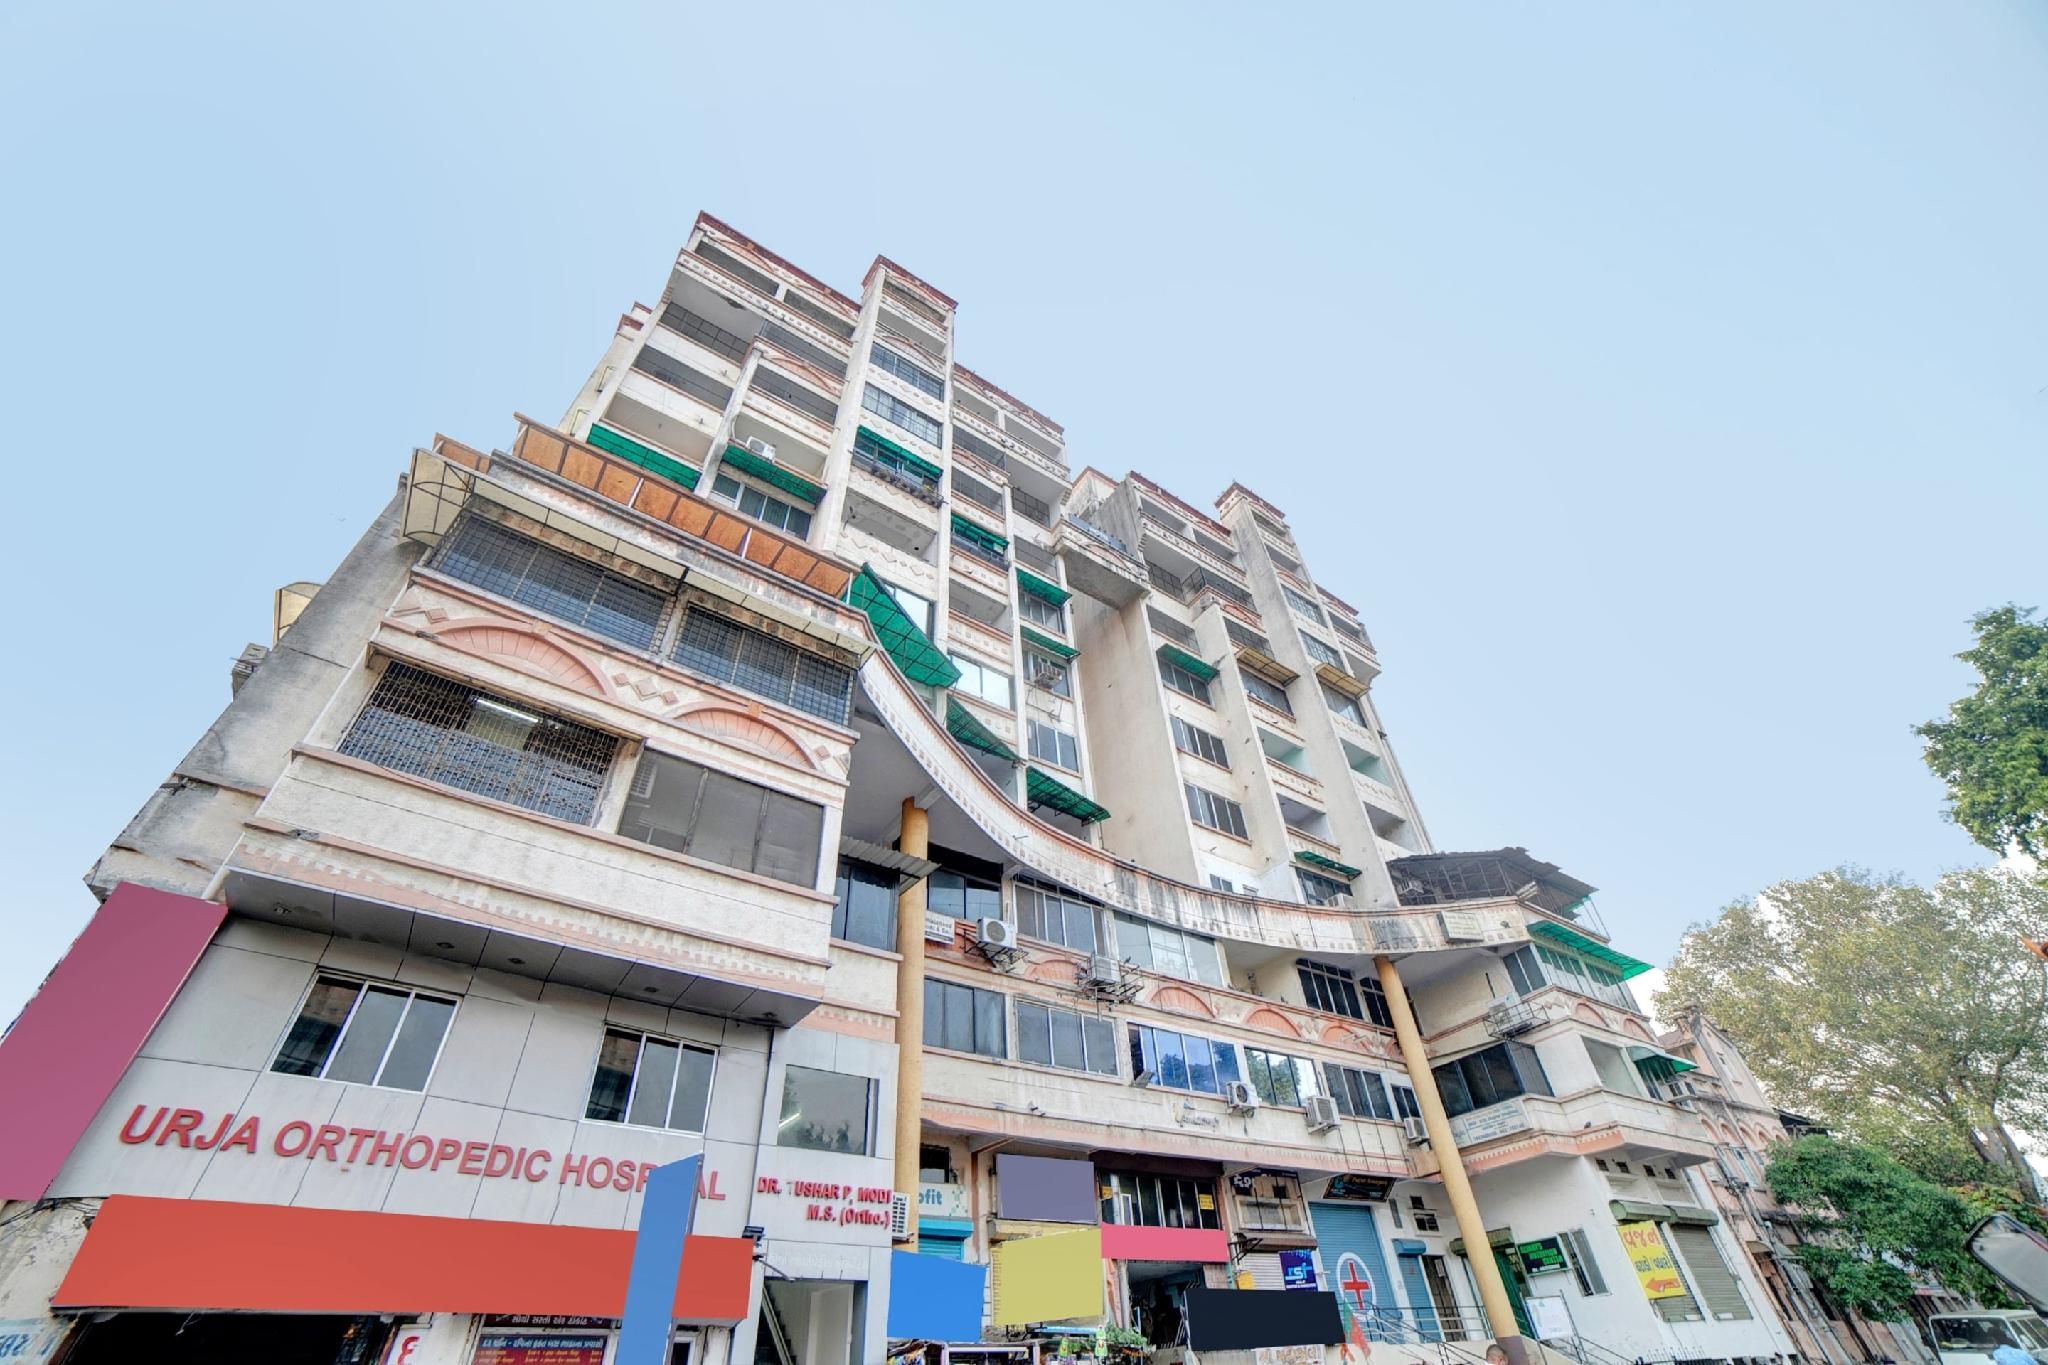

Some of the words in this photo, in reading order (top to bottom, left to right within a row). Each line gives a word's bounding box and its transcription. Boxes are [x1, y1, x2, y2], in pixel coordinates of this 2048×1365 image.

[120, 1104, 260, 1154] URJA
[274, 1120, 552, 1182] ORTHOPEDIC
[559, 1153, 726, 1201] HOSPL
[757, 1177, 782, 1194] DR.
[857, 1187, 892, 1203] MODI
[807, 1204, 837, 1222] M.S.
[840, 1207, 890, 1229] (Ortho.)
